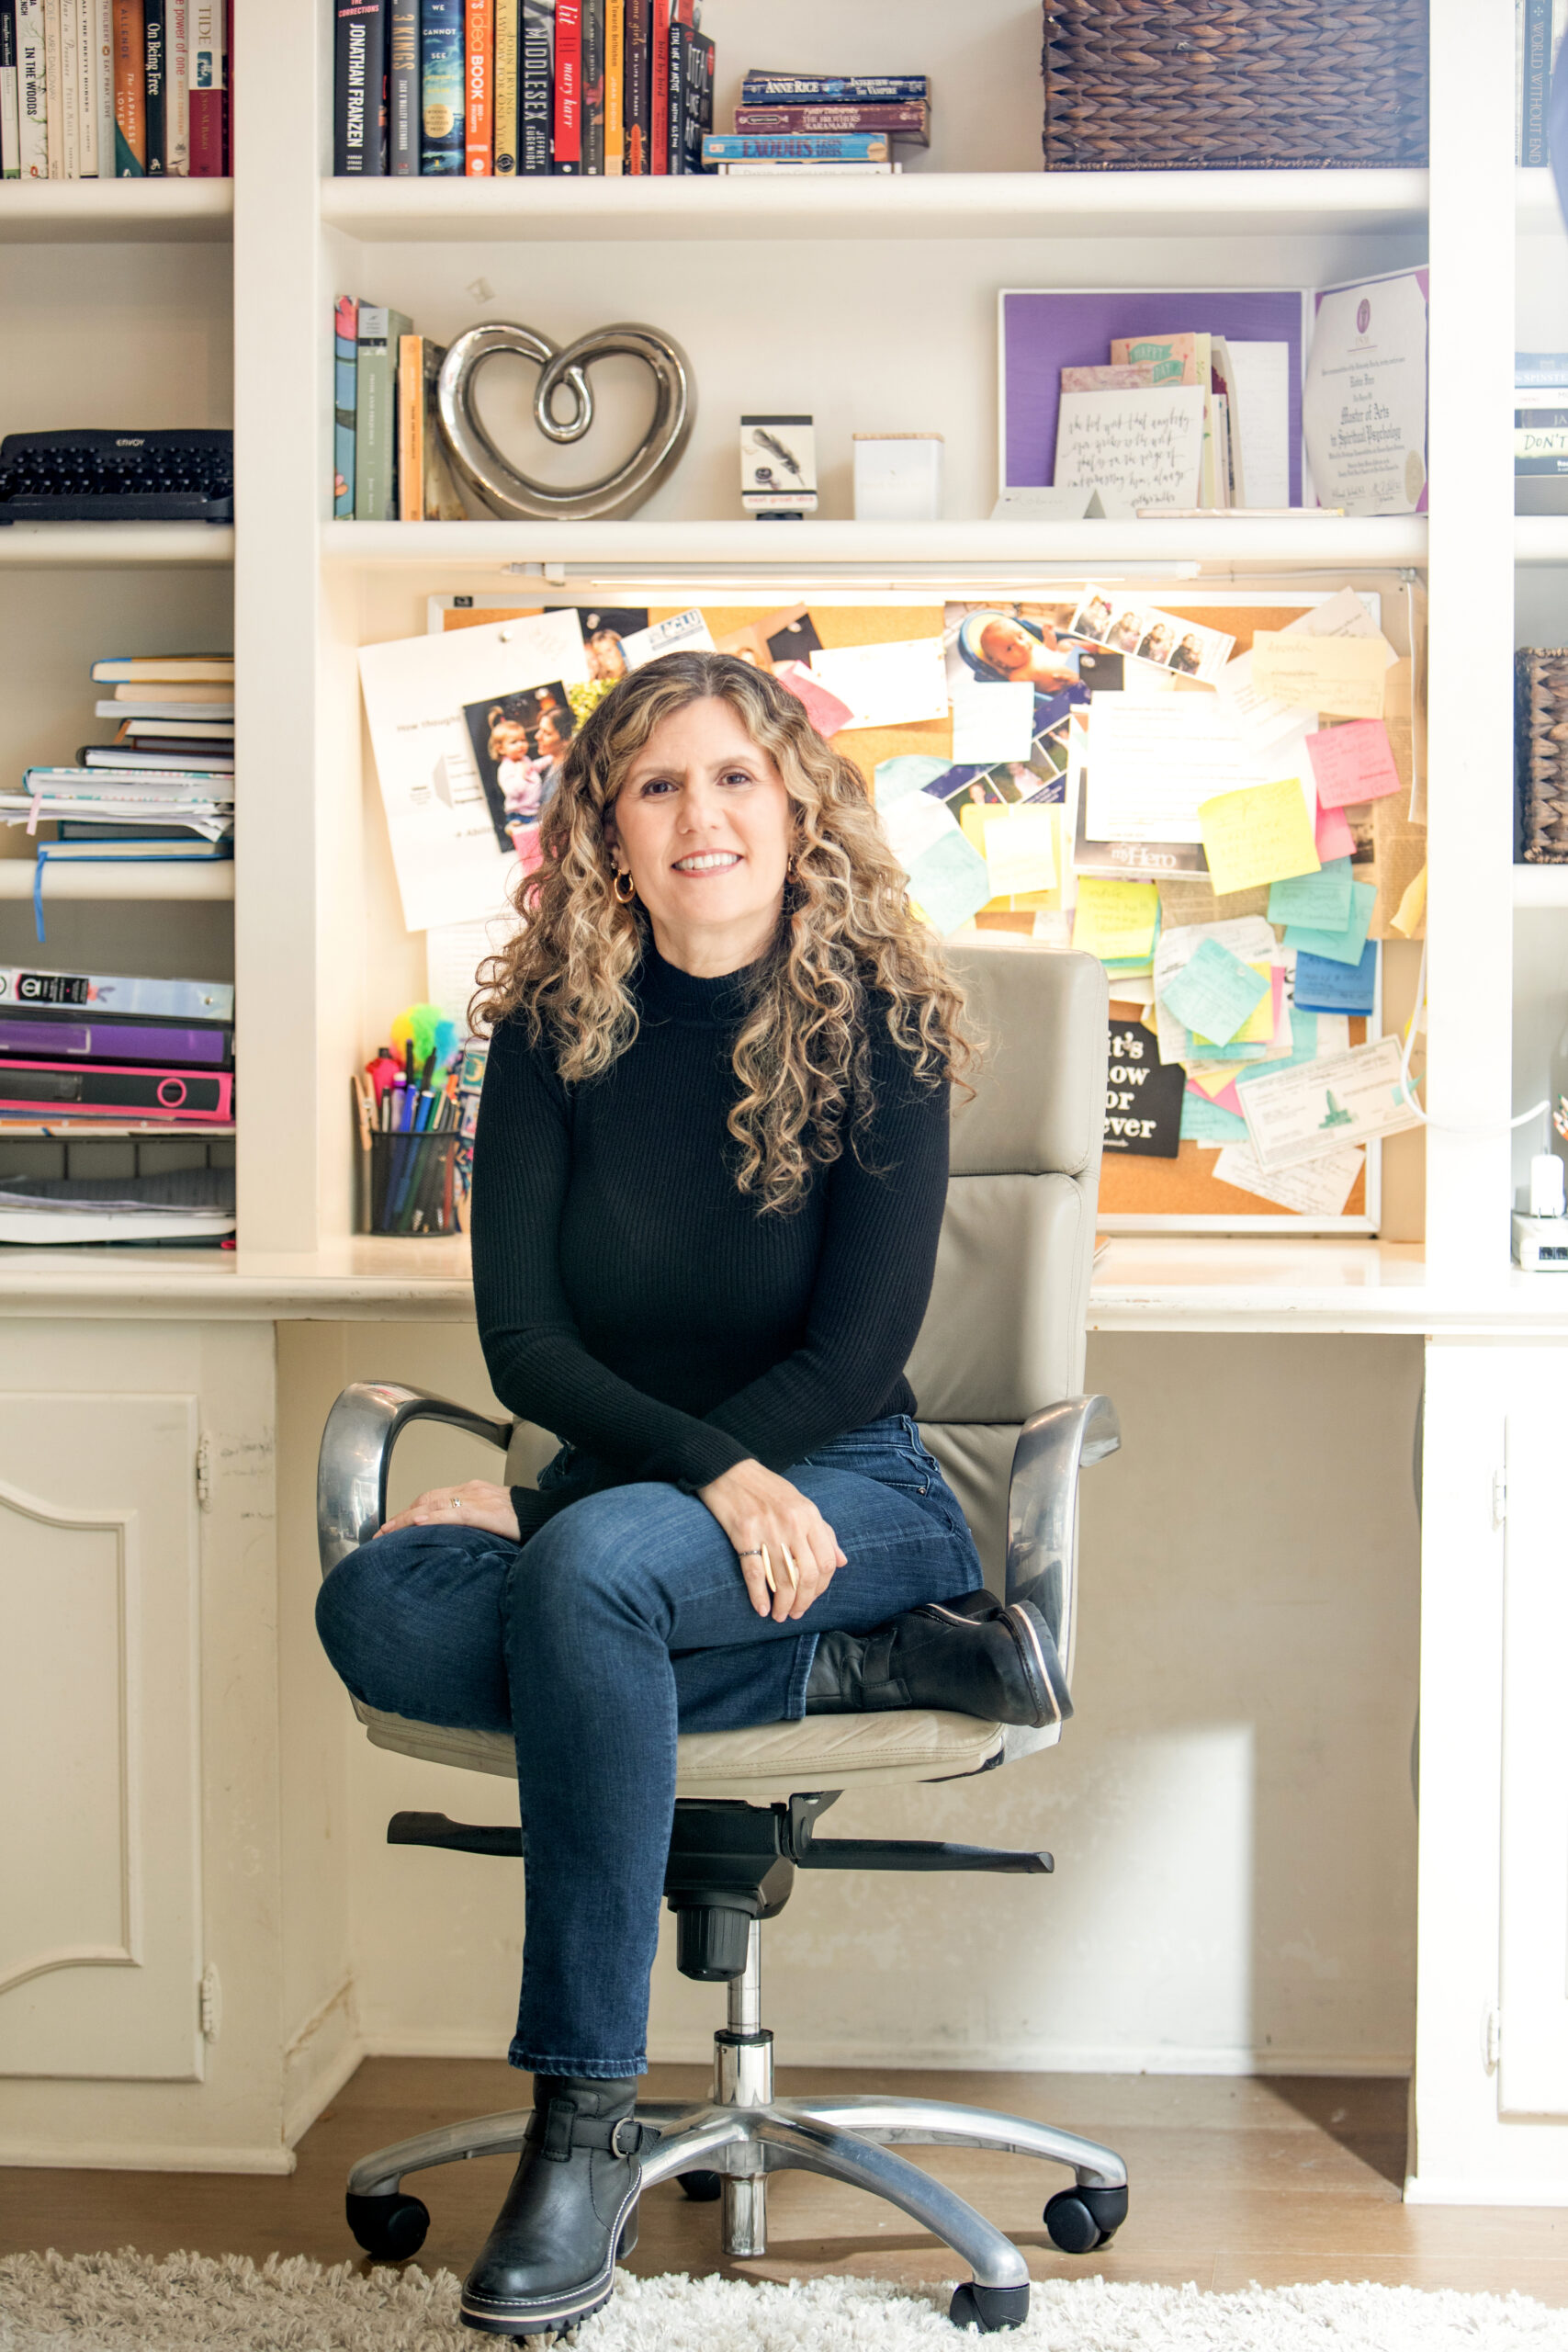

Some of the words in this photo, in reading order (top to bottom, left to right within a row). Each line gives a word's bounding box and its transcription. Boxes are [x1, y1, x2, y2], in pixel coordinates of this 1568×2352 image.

[174, 9, 186, 40] power
[338, 5, 379, 17] CORRECTIONS
[392, 14, 415, 22] 3
[558, 5, 578, 26] lit
[611, 6, 619, 32] Towards
[102, 13, 110, 43] GILBERT
[147, 23, 162, 40] On
[197, 6, 212, 45] TIDE
[470, 13, 487, 51] idea
[497, 17, 507, 60] WIDOW
[628, 23, 645, 46] girls
[671, 28, 680, 45] STEAL
[25, 47, 36, 59] IN
[144, 42, 161, 71] Being
[176, 43, 187, 53] of
[348, 23, 367, 86] JONATHAN
[392, 27, 415, 71] KINGS
[506, 33, 516, 64] JOHN
[611, 34, 619, 67] Bethlehem
[658, 40, 666, 60] bird
[1530, 21, 1544, 69] WORLD
[26, 61, 36, 79] THE
[176, 57, 186, 75] one
[470, 55, 484, 100] BOOK
[524, 28, 547, 121] MIDDLESEX
[558, 62, 574, 96] mary
[657, 63, 665, 74] by
[671, 62, 680, 71] AN
[147, 73, 162, 96] Free
[506, 72, 516, 116] IRVING
[610, 76, 618, 99] JOAN
[657, 77, 666, 97] bird
[671, 72, 680, 93] ARTIST
[764, 81, 795, 94] ANNE
[795, 81, 819, 93] RICE
[27, 81, 38, 116] WOODS
[118, 92, 126, 127] LOVER
[1529, 73, 1544, 135] WITHOUT
[128, 90, 136, 144] JAPANESE
[346, 88, 365, 148] FRANZEN
[563, 98, 577, 129] karr
[610, 102, 618, 132] DIDION
[525, 126, 536, 170] EUGENIDES
[536, 130, 545, 165] JEFFREY
[742, 139, 814, 158] EXODUS
[1528, 138, 1542, 164] END
[116, 438, 145, 447] ENVOY
[1108, 1065, 1150, 1086] ow
[1105, 1090, 1135, 1111] or
